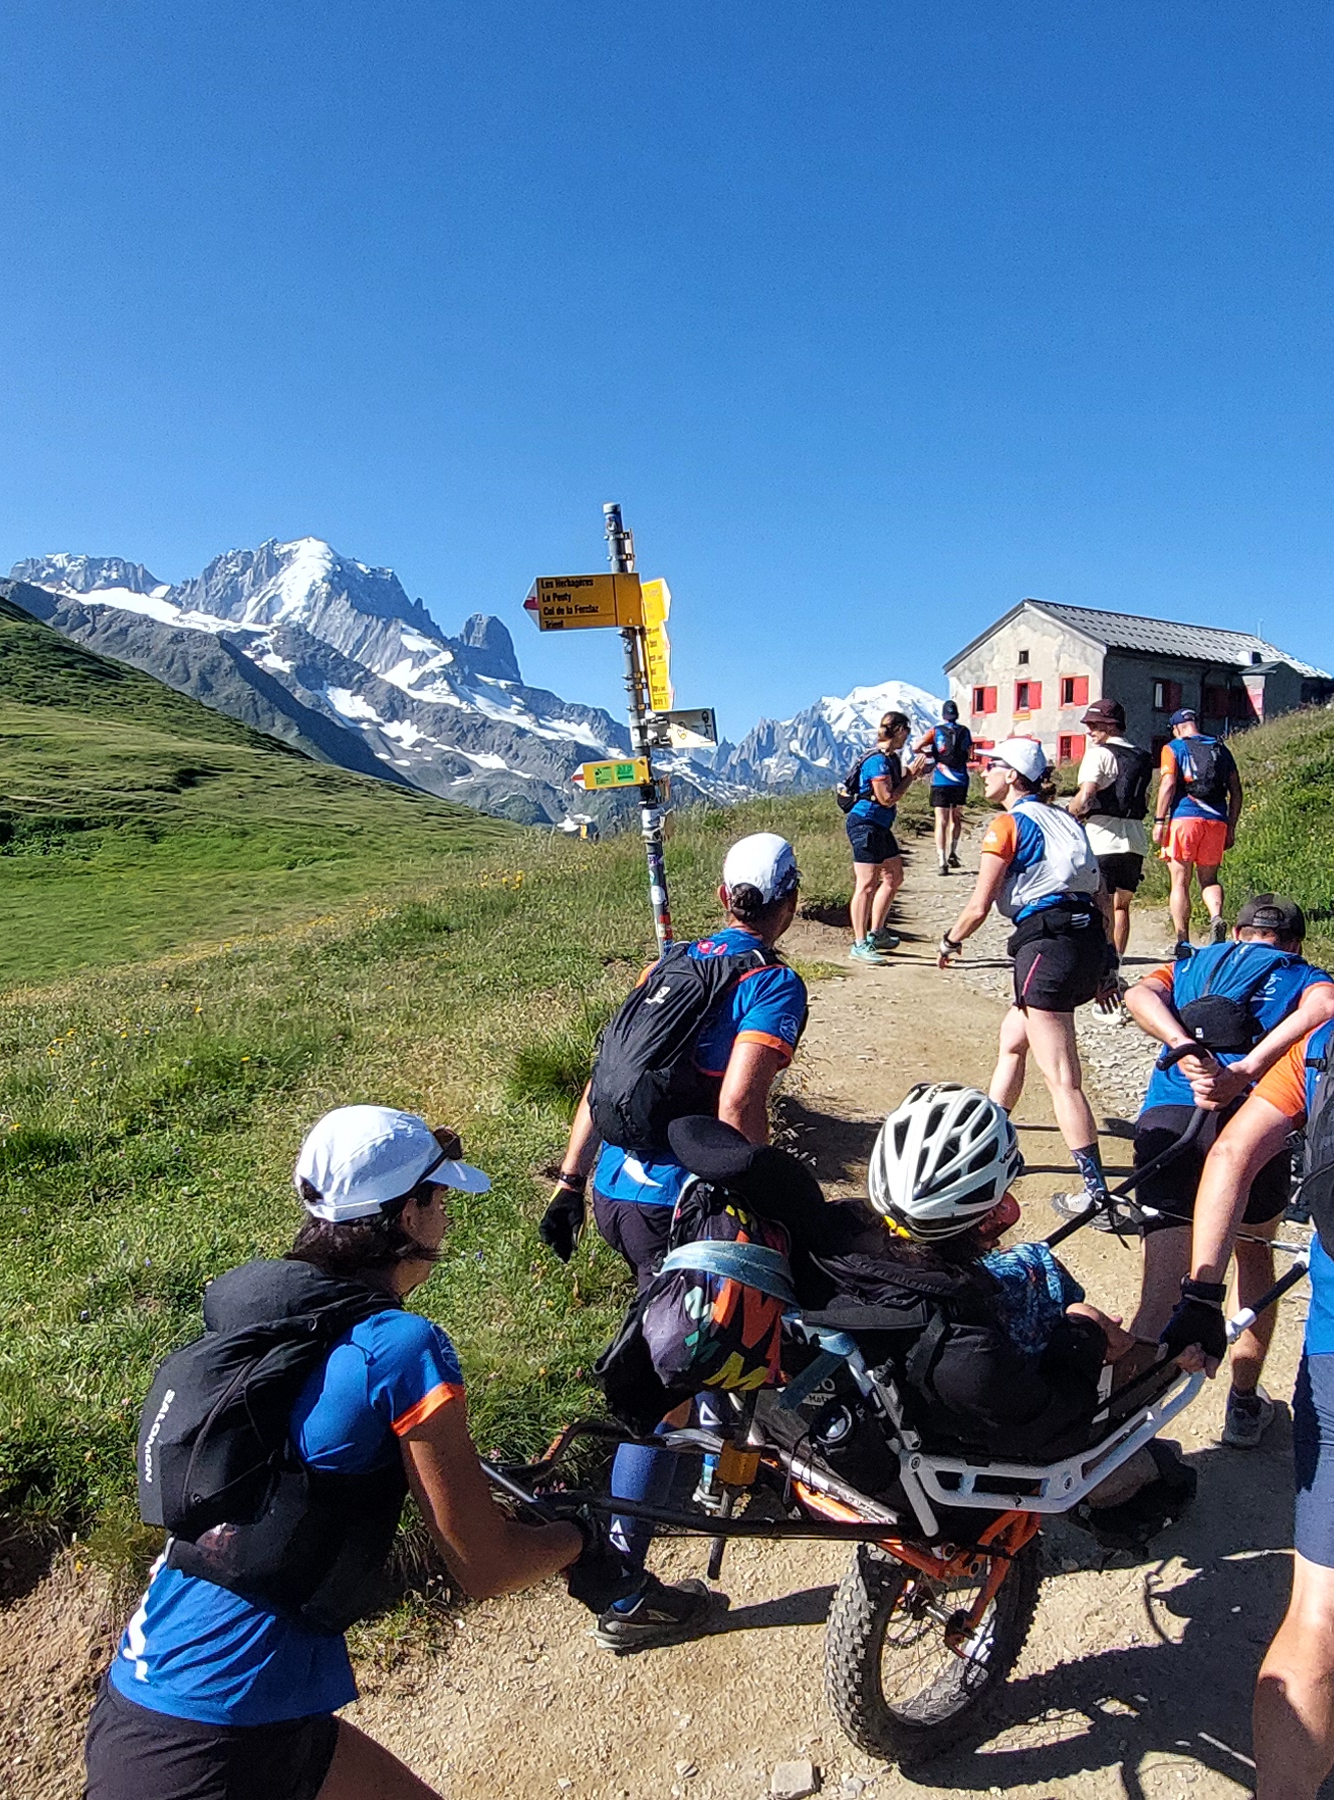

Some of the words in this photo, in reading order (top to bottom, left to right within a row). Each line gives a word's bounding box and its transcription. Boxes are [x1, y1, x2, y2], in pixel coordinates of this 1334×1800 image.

[556, 607, 565, 615] de
[566, 606, 573, 614] la
[145, 1389, 175, 1483] SALOMON
